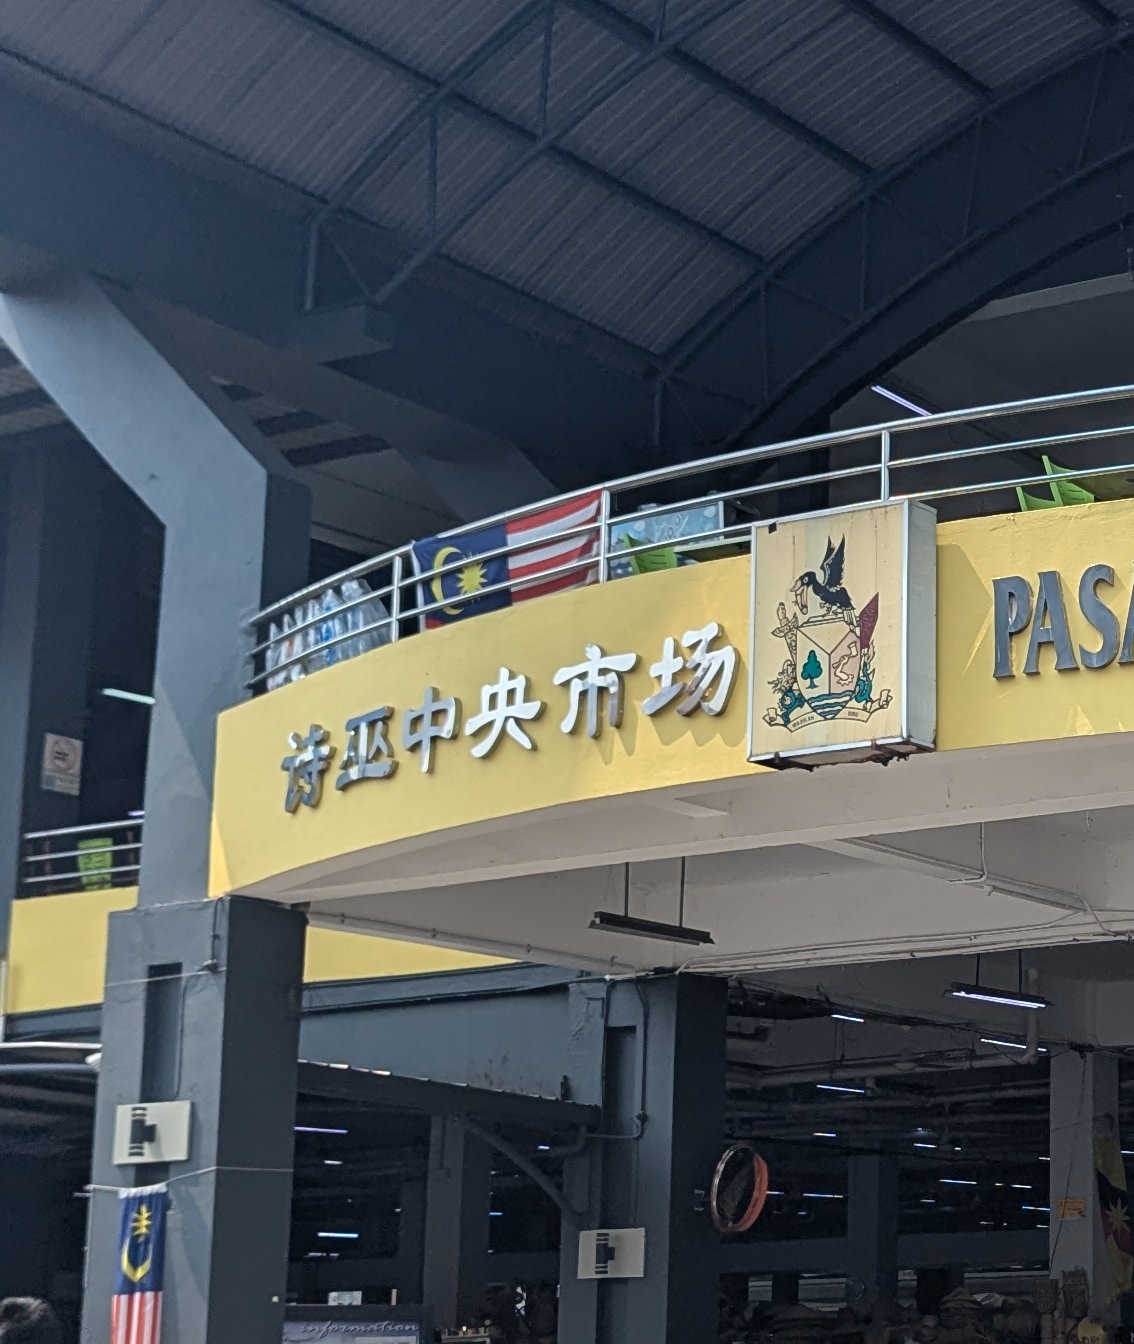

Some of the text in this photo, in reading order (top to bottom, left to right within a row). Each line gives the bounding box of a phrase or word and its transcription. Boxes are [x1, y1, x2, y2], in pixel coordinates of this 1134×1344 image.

[281, 621, 739, 814] 诗巫中央市场
[300, 1320, 419, 1339] information
